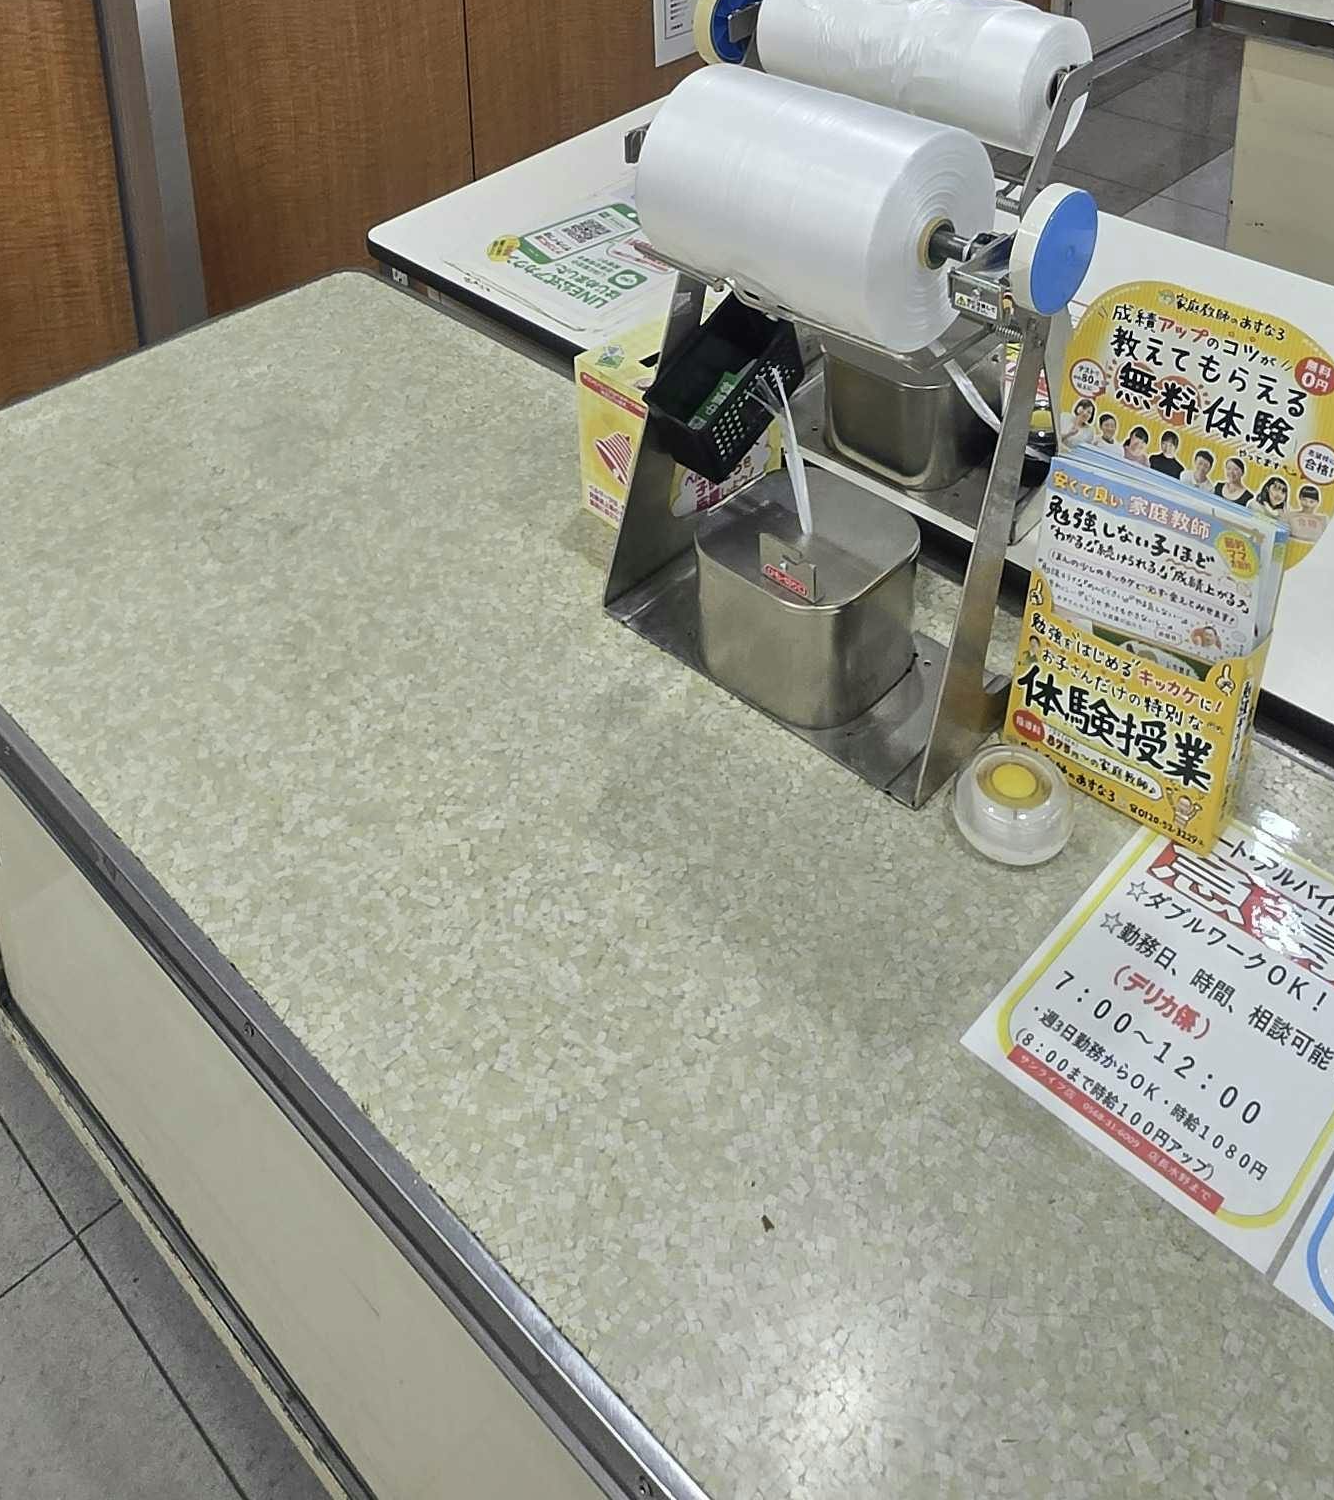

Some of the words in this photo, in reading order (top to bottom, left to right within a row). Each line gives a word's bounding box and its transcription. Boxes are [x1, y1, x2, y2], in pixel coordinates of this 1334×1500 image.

[1112, 304, 1278, 366] 成績アップのコツが
[1176, 294, 1286, 341] 家庭教師のあすなろ
[1110, 325, 1308, 418] 教えてもらえる
[1115, 362, 1294, 458] 無料体験
[1304, 459, 1334, 478] 合格！
[1045, 494, 1215, 569] 勉強しない子ほど
[1128, 495, 1211, 540] 家庭教師
[1042, 648, 1204, 732] お子さんだけの特別な
[1017, 664, 1214, 792] 体験授業
